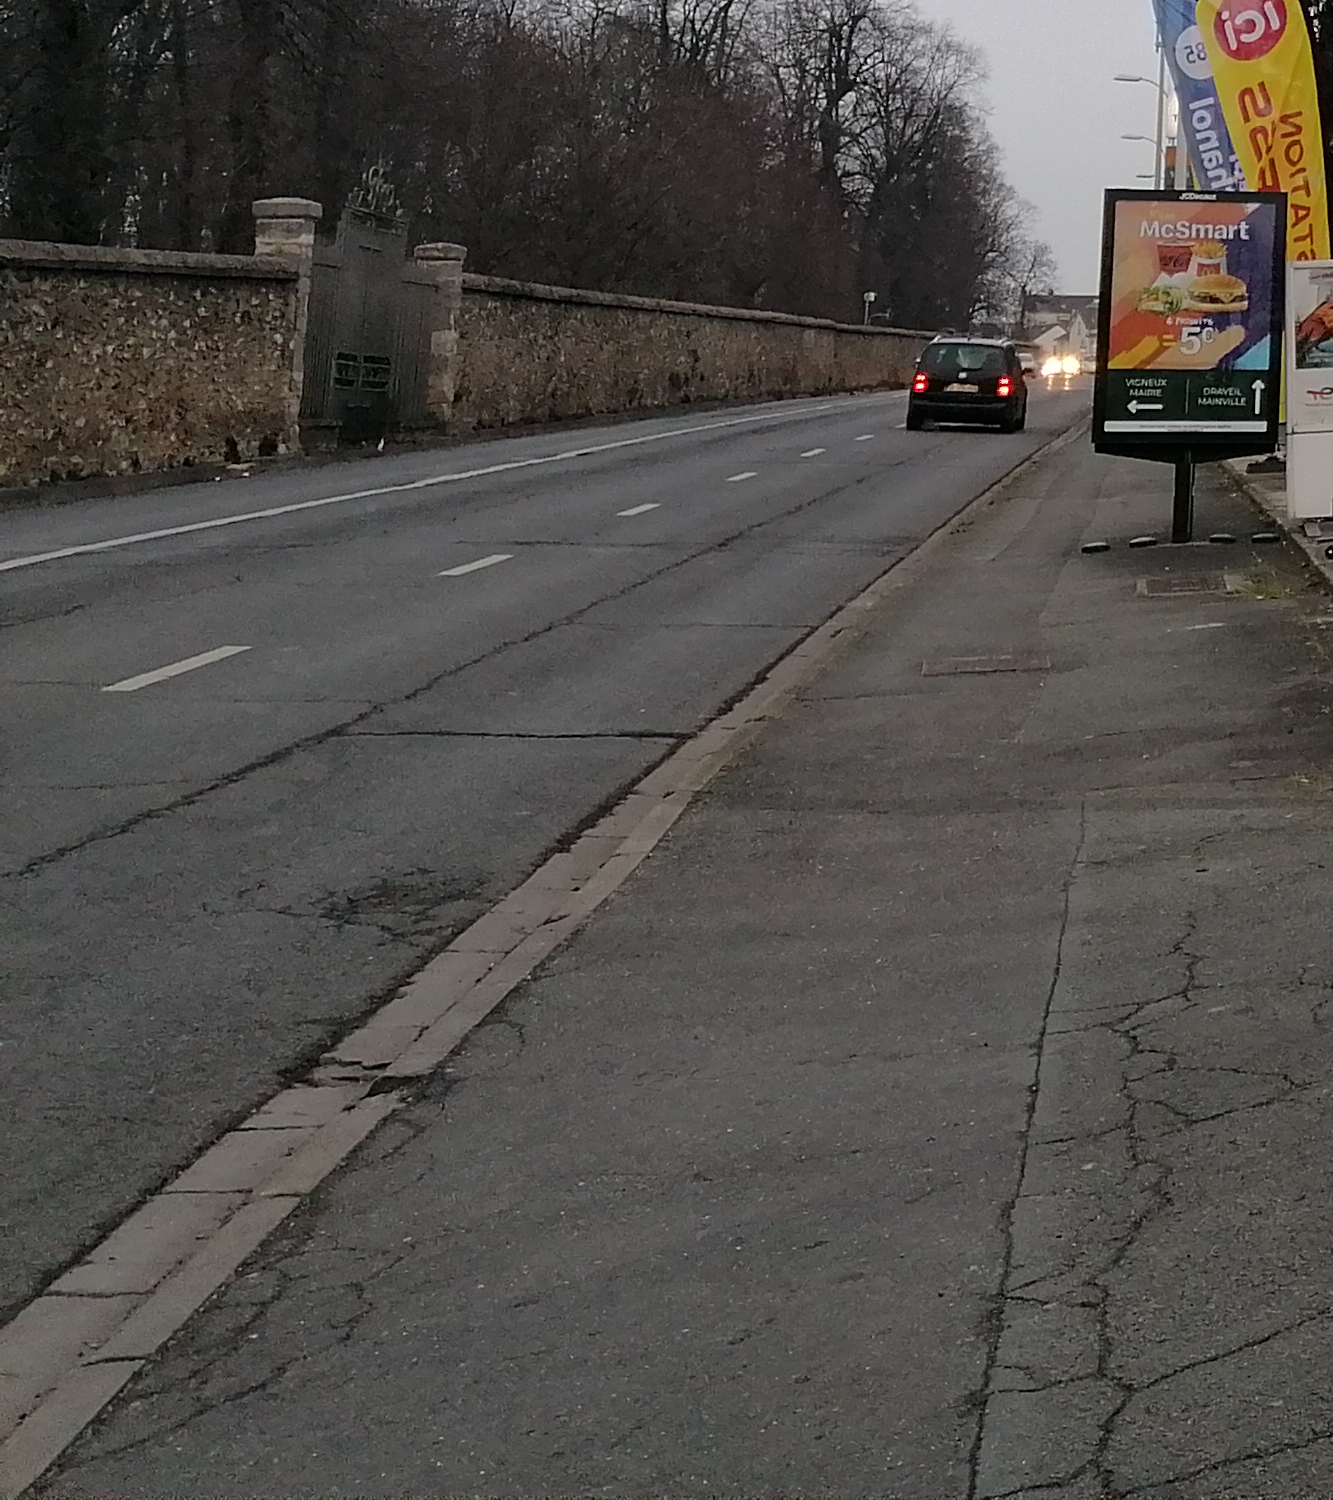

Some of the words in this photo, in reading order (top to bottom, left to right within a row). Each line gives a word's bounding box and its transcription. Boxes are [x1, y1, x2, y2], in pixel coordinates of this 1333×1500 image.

[1140, 220, 1250, 240] McSmart
[1125, 378, 1168, 387] VIGNEUX
[1129, 388, 1163, 397] MAIRIE
[1203, 387, 1242, 396] DRAVEIL
[1197, 397, 1248, 406] MAINVILLE
